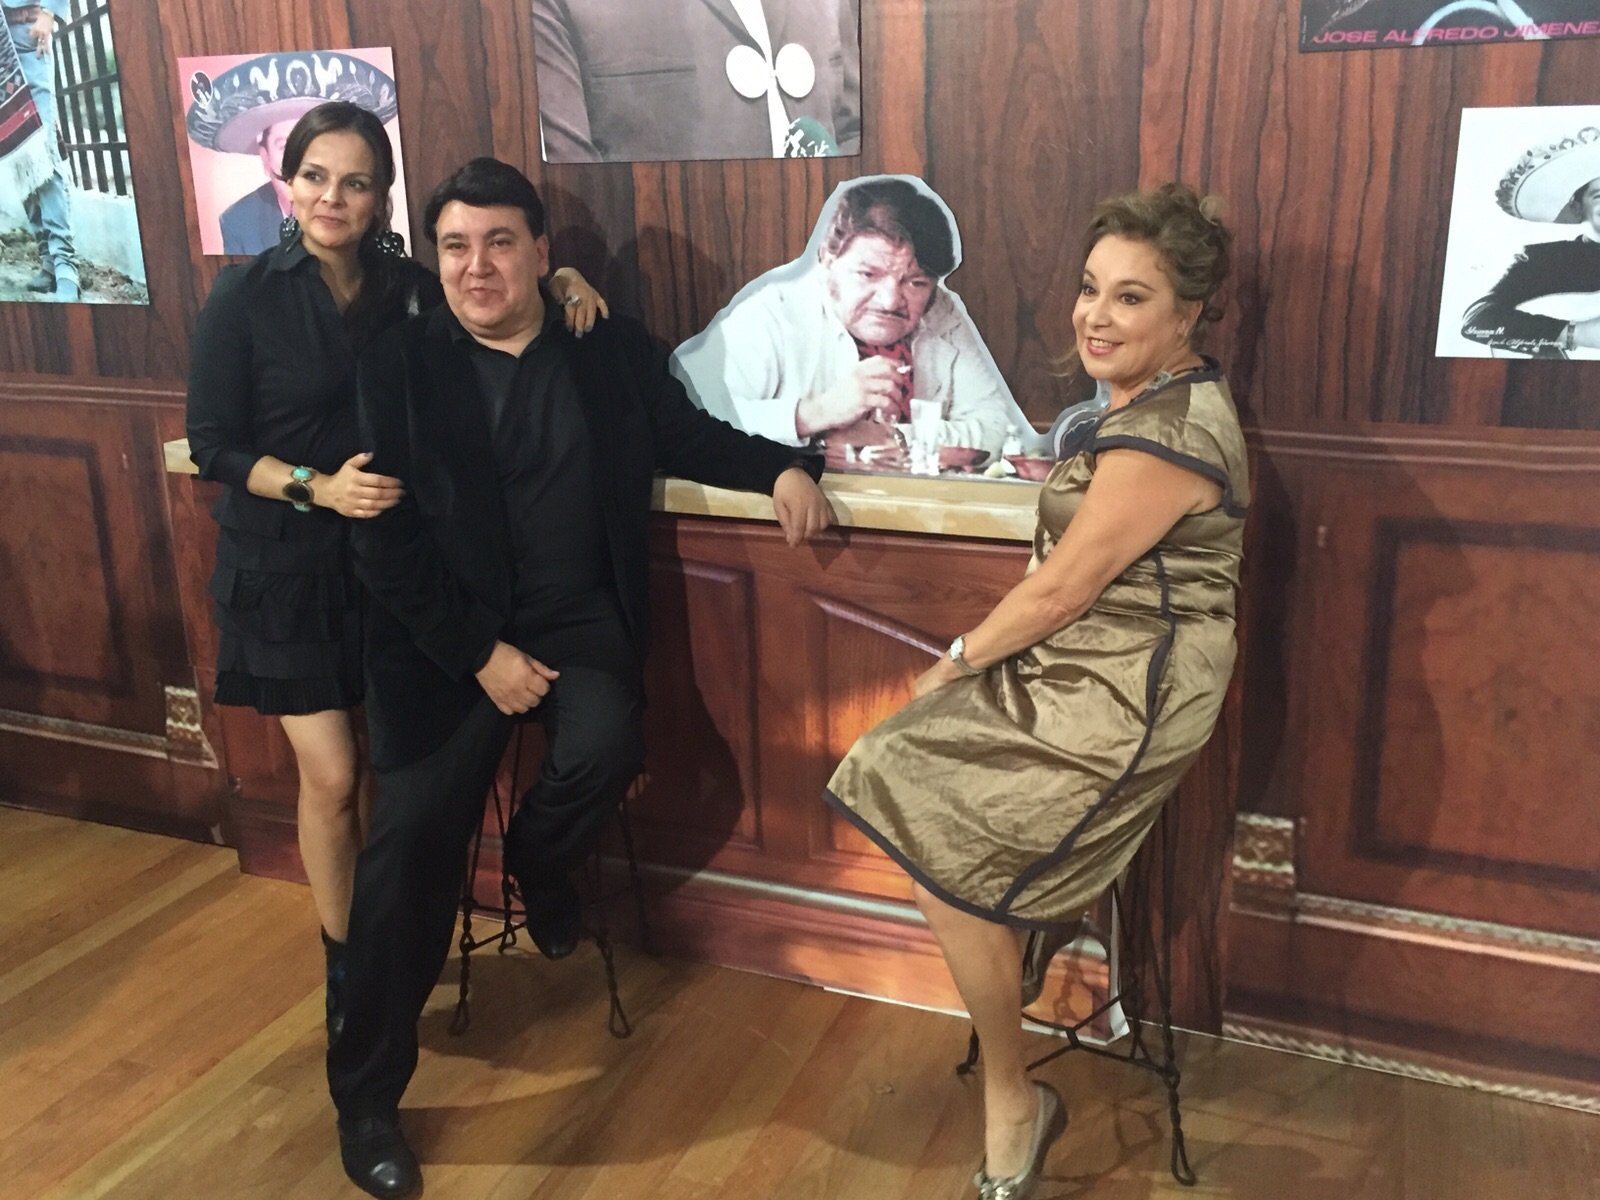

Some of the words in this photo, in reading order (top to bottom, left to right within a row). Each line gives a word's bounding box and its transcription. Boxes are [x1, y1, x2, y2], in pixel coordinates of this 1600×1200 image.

[1312, 30, 1377, 44] JOSE
[1383, 26, 1499, 43] ALFREDO
[1503, 21, 1600, 38] JIMENE
